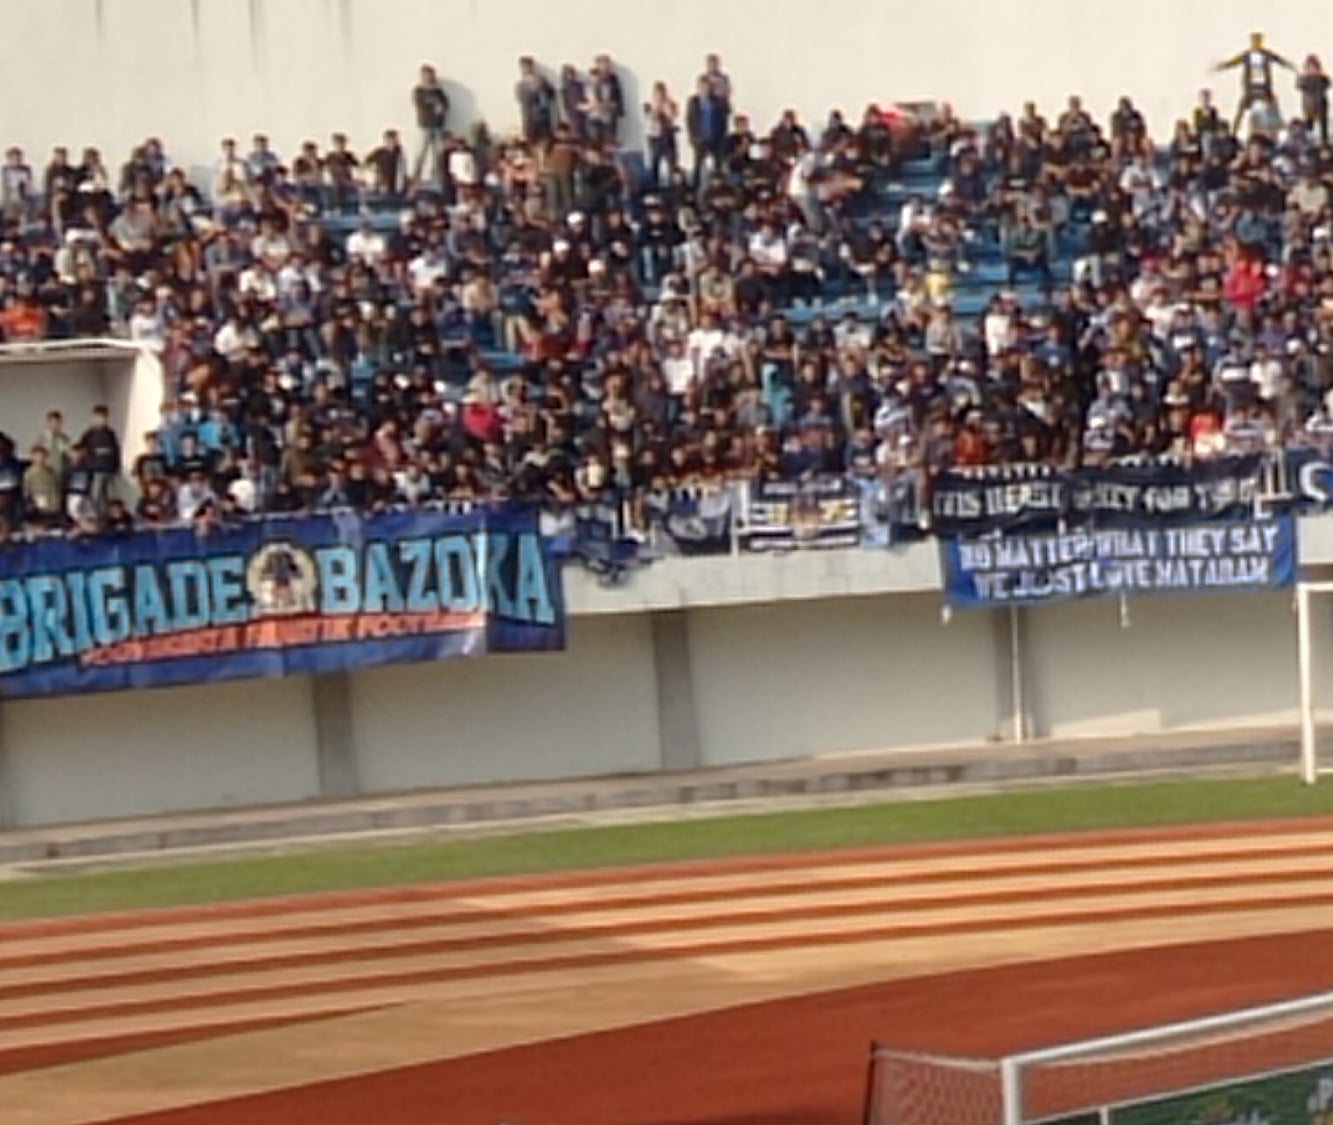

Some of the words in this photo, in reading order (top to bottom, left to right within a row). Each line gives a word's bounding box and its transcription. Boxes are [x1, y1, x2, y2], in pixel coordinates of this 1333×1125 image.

[1166, 526, 1228, 554] THEY
[1229, 524, 1280, 552] SAY
[0, 555, 248, 673] BRIGADE
[315, 531, 555, 625] BAZOKA
